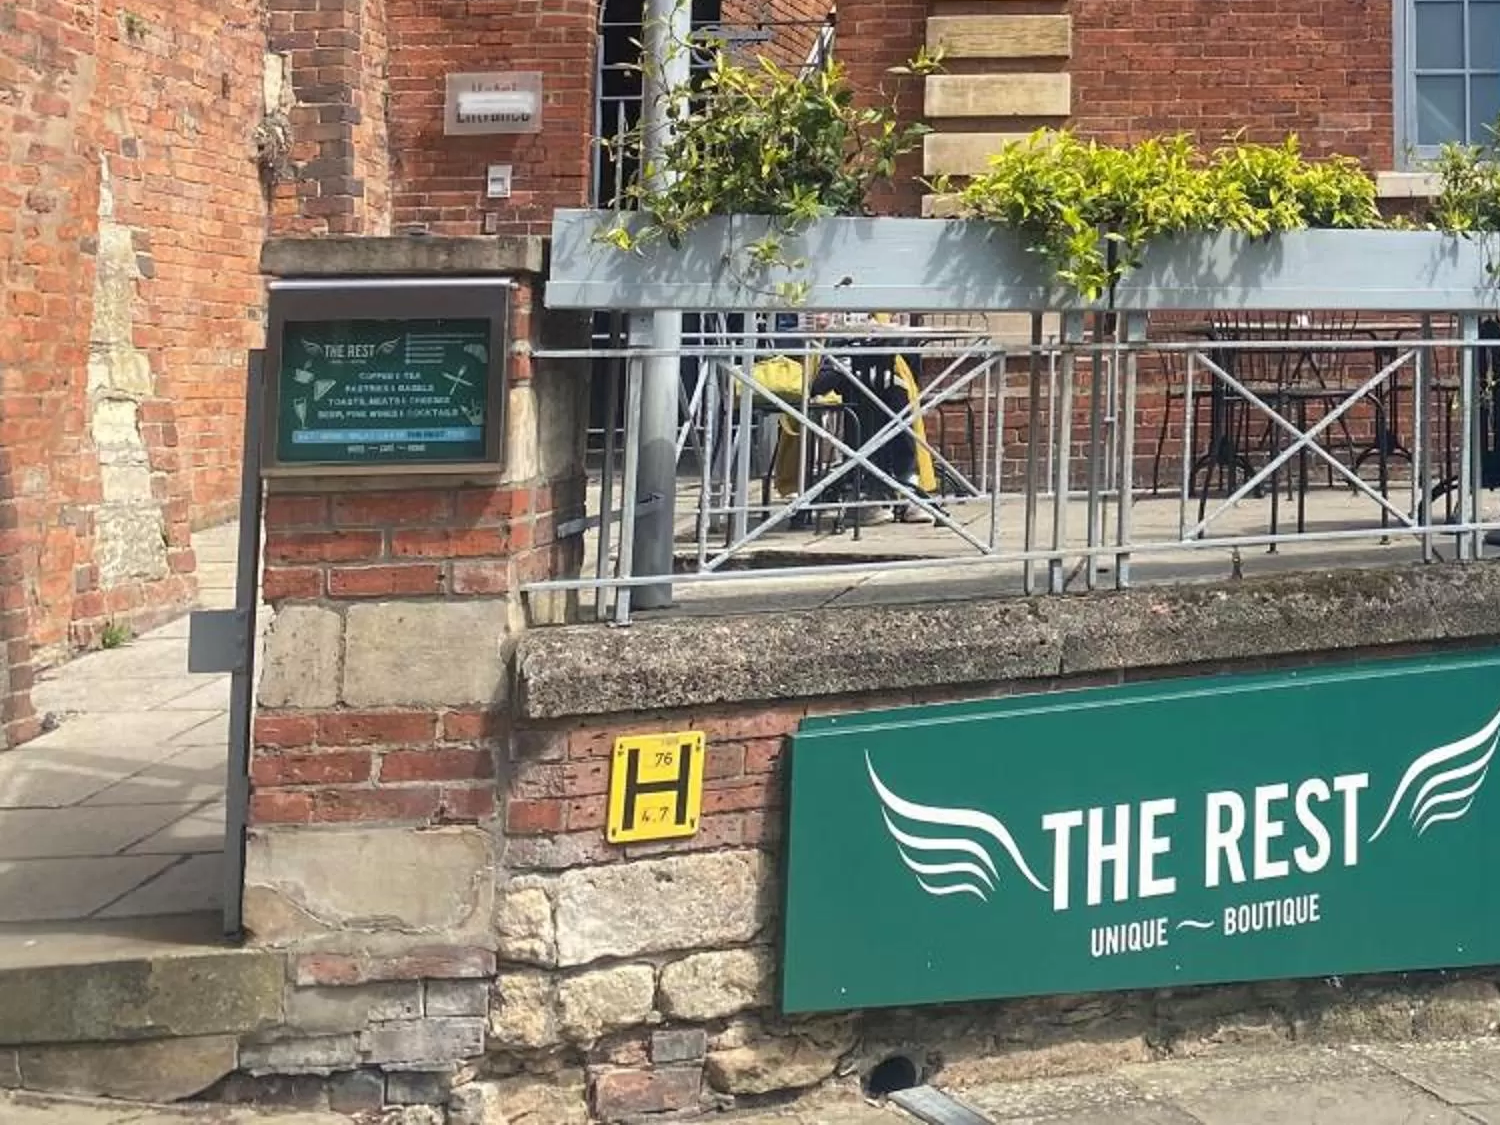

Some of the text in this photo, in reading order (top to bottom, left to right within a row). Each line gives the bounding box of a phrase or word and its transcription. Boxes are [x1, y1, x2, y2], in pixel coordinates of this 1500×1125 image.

[324, 344, 376, 358] THE REST
[622, 743, 692, 831] H
[655, 752, 673, 766] 76
[1042, 773, 1368, 911] THE REST
[1091, 893, 1320, 958] UNIQUE BOUTIQUE
